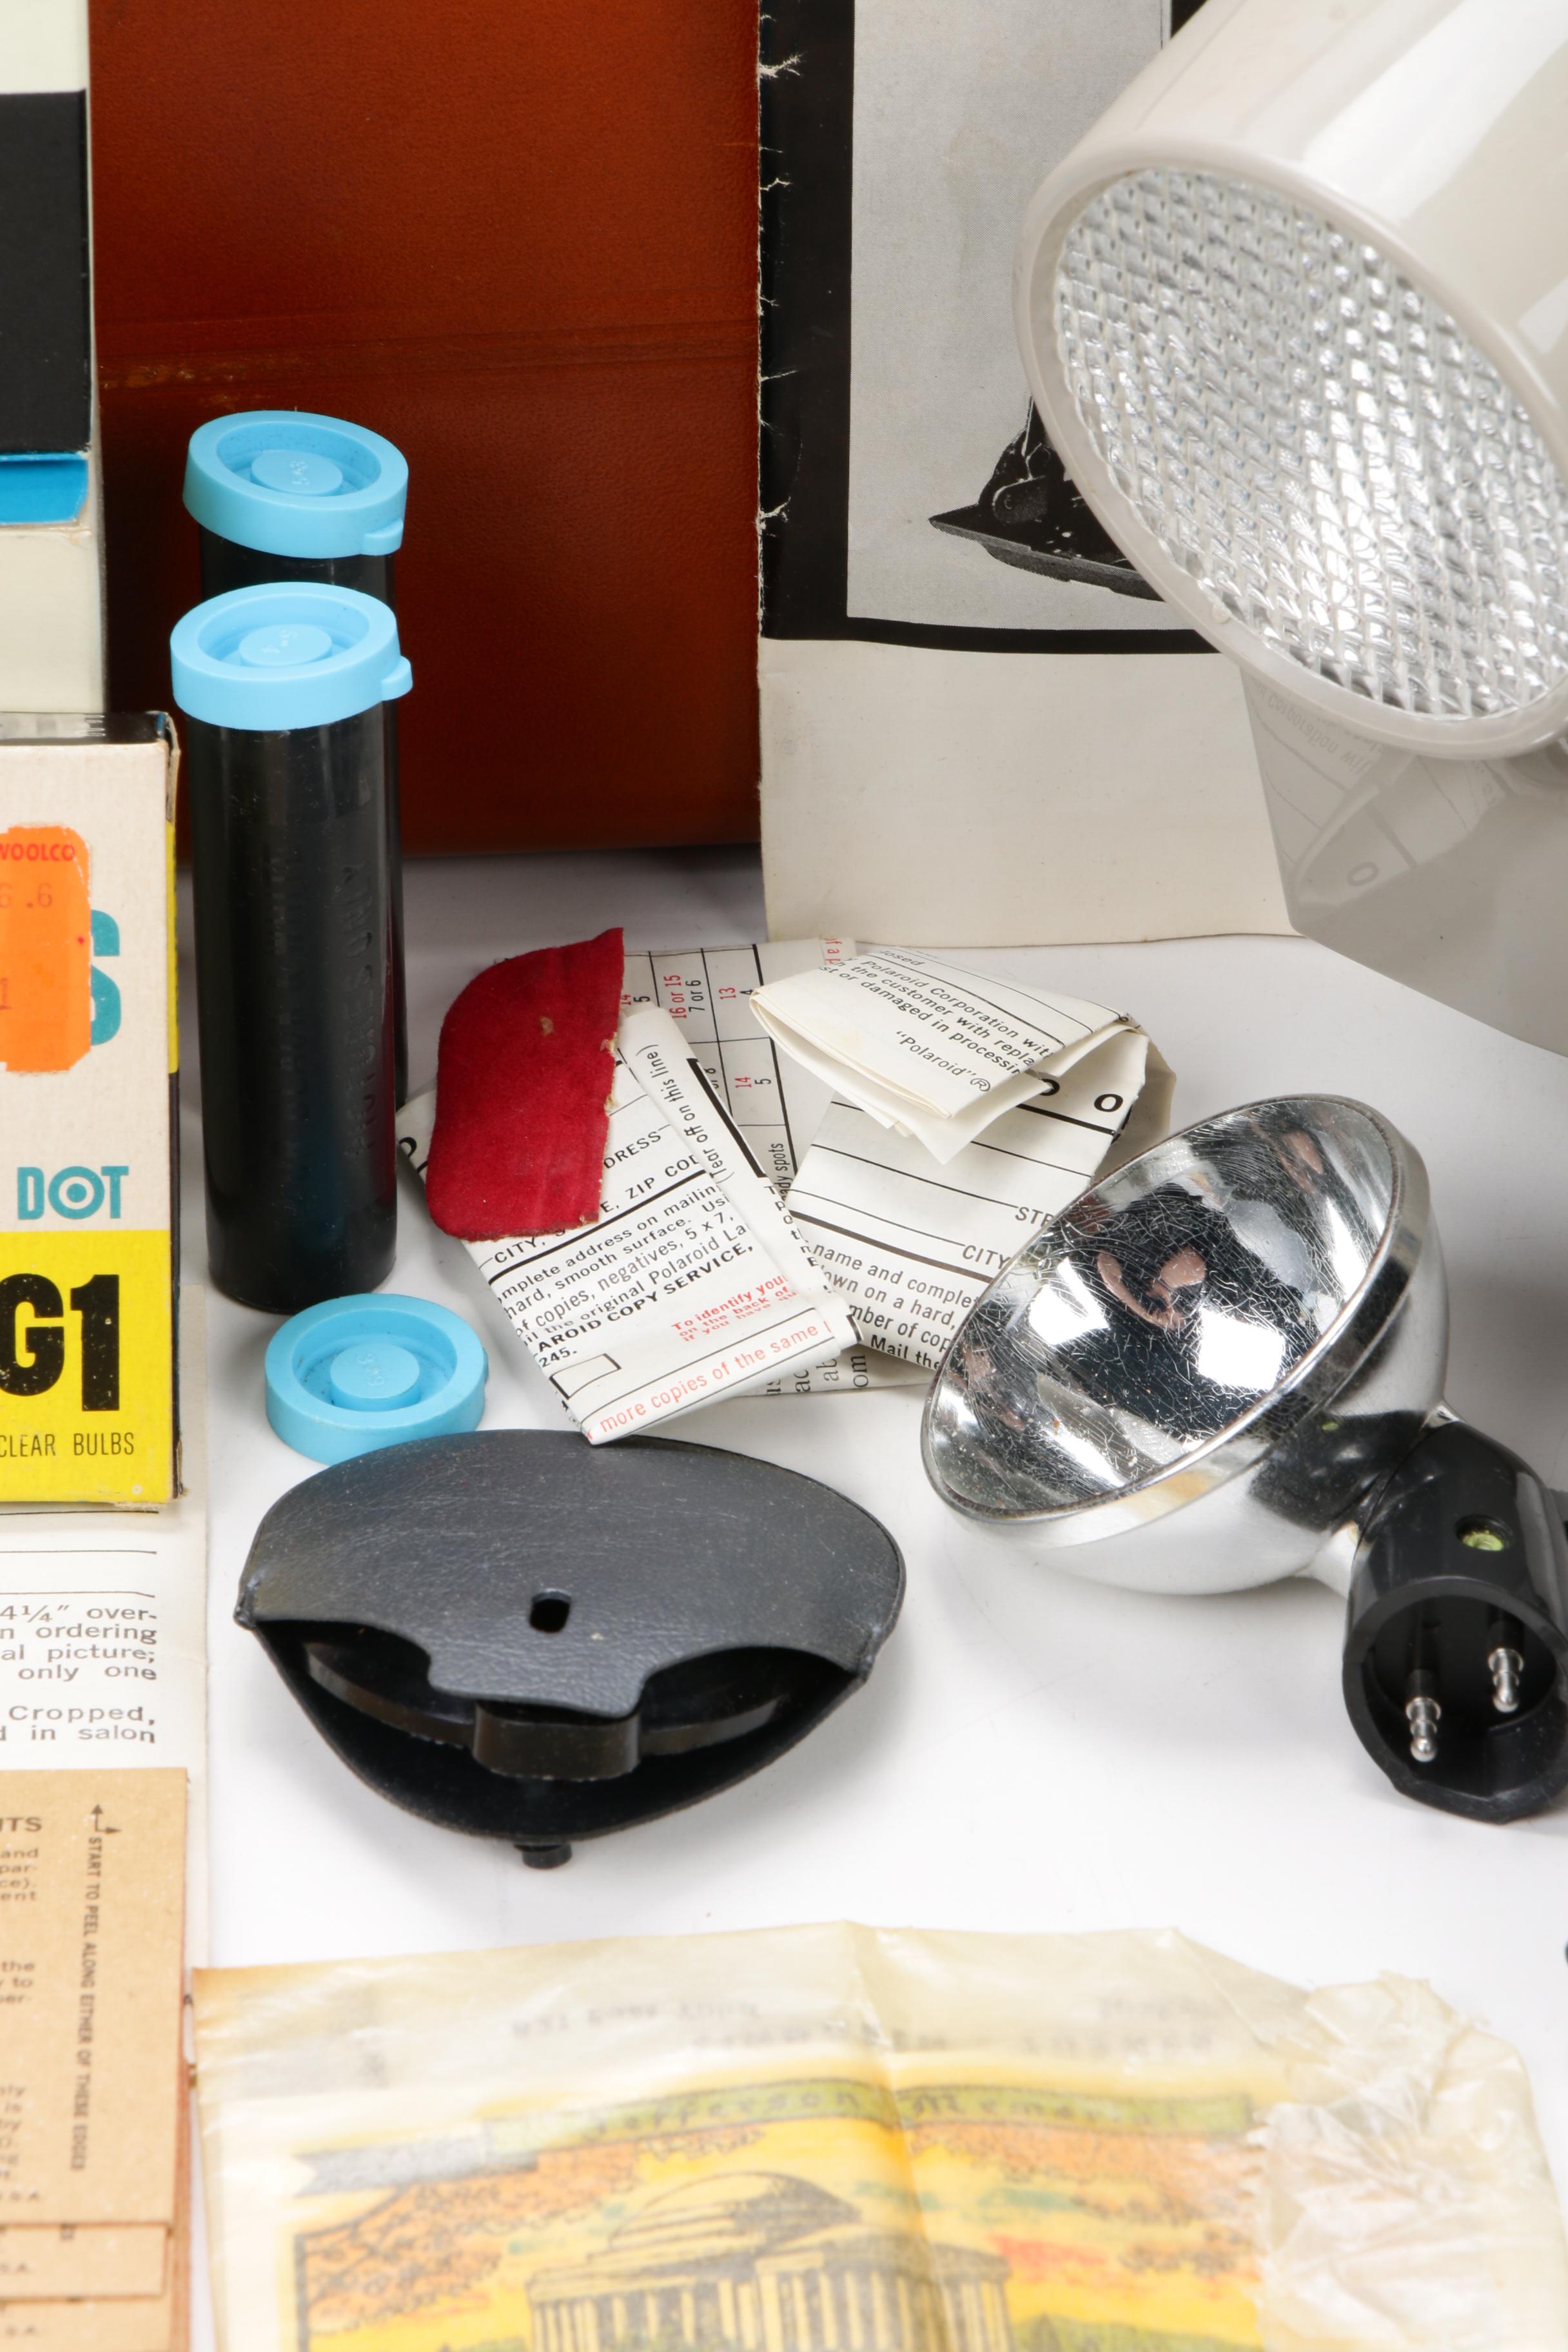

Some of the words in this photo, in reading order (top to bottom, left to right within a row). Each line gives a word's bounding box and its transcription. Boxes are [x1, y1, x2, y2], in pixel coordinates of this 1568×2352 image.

[663, 975, 681, 986] 15
[719, 987, 736, 999] 13
[851, 967, 877, 978] the
[881, 979, 954, 1017] customer
[956, 1017, 990, 1039] with
[861, 961, 930, 987] Polaroid
[930, 988, 1019, 1039] Corporation
[861, 981, 933, 1021] damaged
[932, 1019, 950, 1032] in
[636, 1044, 669, 1078] line)
[660, 1079, 684, 1102] this
[735, 1077, 752, 1088] 14
[679, 1104, 696, 1121] on
[684, 1125, 708, 1142] off
[769, 1143, 790, 1171] spots
[17, 1166, 128, 1220] DOT
[625, 1177, 655, 1199] ZIP
[565, 1229, 632, 1268] address
[637, 1216, 658, 1231] on
[664, 1184, 720, 1216] mailin
[504, 1288, 551, 1320] hard,
[554, 1254, 617, 1290] smooth
[623, 1219, 691, 1254] surface.
[536, 1289, 595, 1327] copies,
[598, 1240, 684, 1291] negatives,
[685, 1228, 697, 1240] 5
[714, 1212, 734, 1224] 7,
[813, 1244, 863, 1271] name
[867, 1264, 903, 1285] and
[545, 1320, 574, 1334] the
[580, 1280, 645, 1320] original
[649, 1237, 720, 1285] Polaroid
[607, 1291, 658, 1321] COPY
[663, 1242, 753, 1295] SERVICE,
[671, 1318, 693, 1330] To
[694, 1291, 753, 1320] identify
[756, 1275, 789, 1296] you
[679, 1326, 698, 1337] on
[703, 1314, 728, 1327] the
[733, 1298, 770, 1315] back
[865, 1288, 887, 1302] on
[894, 1297, 905, 1309] a
[910, 1299, 956, 1331] hard,
[702, 1320, 730, 1335] you
[897, 1323, 917, 1338] of
[871, 1335, 907, 1359] Mail
[600, 1403, 646, 1432] more
[651, 1375, 708, 1408] copies
[712, 1362, 730, 1380] of
[734, 1349, 765, 1369] the
[770, 1326, 818, 1354] same
[74, 1432, 134, 1455] BULBS
[86, 1608, 157, 1620] over-
[35, 1623, 157, 1645] ordering
[47, 1644, 155, 1663] picture;
[18, 1665, 79, 1682] only
[104, 1666, 157, 1680] one
[9, 1706, 155, 1726] Cropped,
[31, 1725, 56, 1740] in
[79, 1725, 155, 1743] salon
[88, 1838, 102, 1877] START
[86, 1883, 100, 1900] TO
[84, 1905, 99, 1937] PEEL
[81, 1942, 97, 1988] ALONG
[77, 1995, 95, 2043] EITHER
